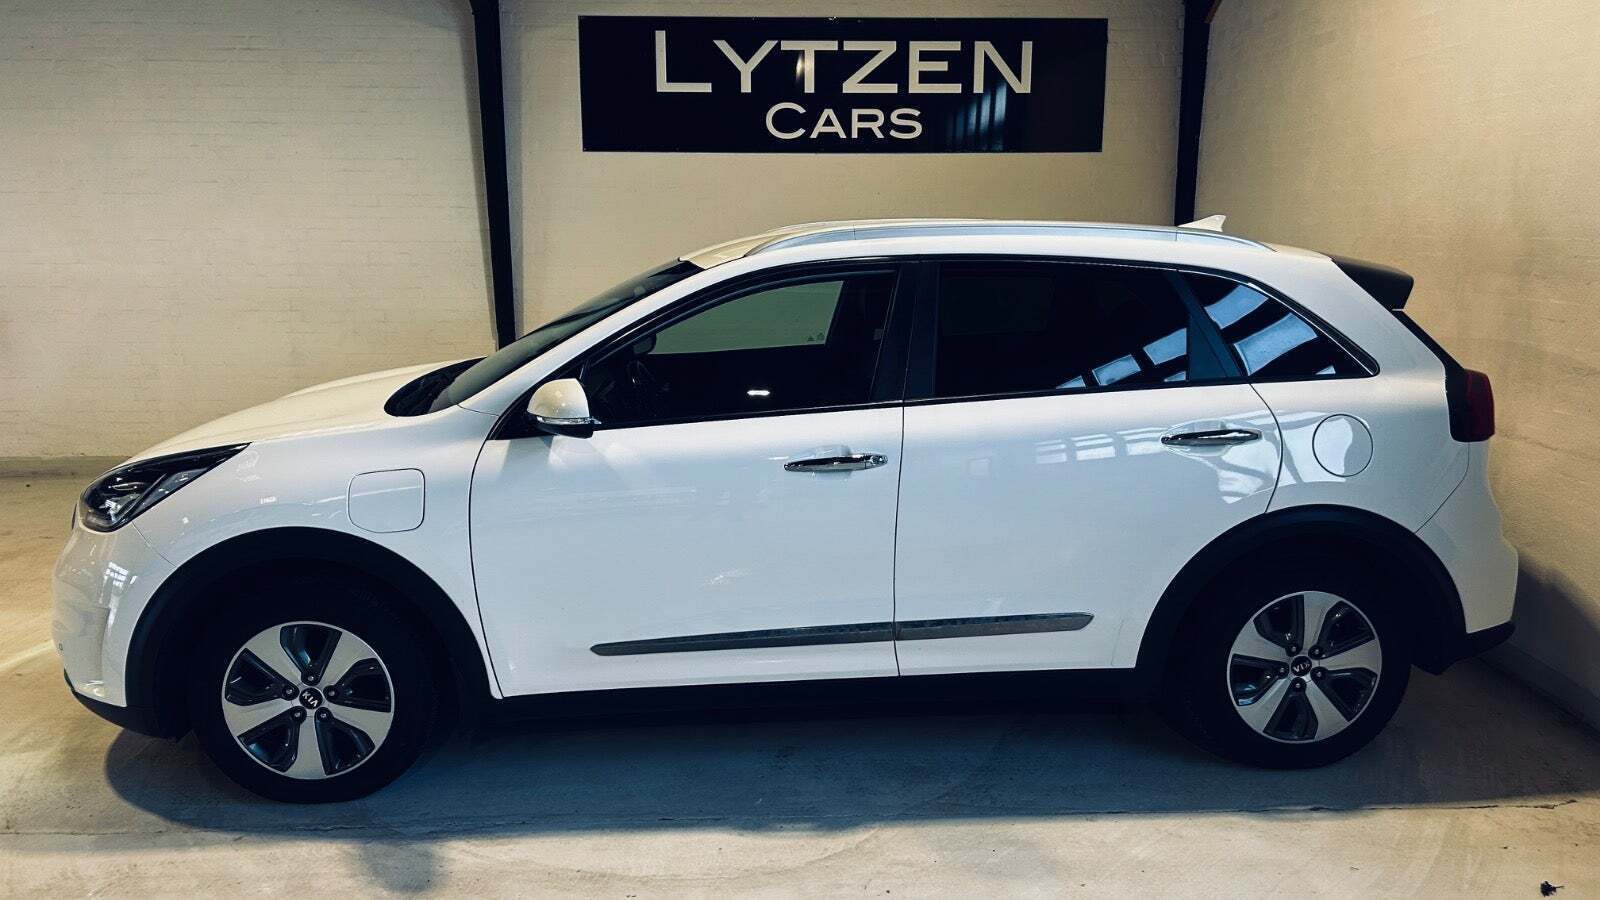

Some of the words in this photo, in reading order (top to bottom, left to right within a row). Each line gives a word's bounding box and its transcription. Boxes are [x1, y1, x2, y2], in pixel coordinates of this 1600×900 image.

[655, 30, 1033, 94] LYTZEN
[765, 102, 923, 140] CARS
[302, 691, 318, 707] KIA
